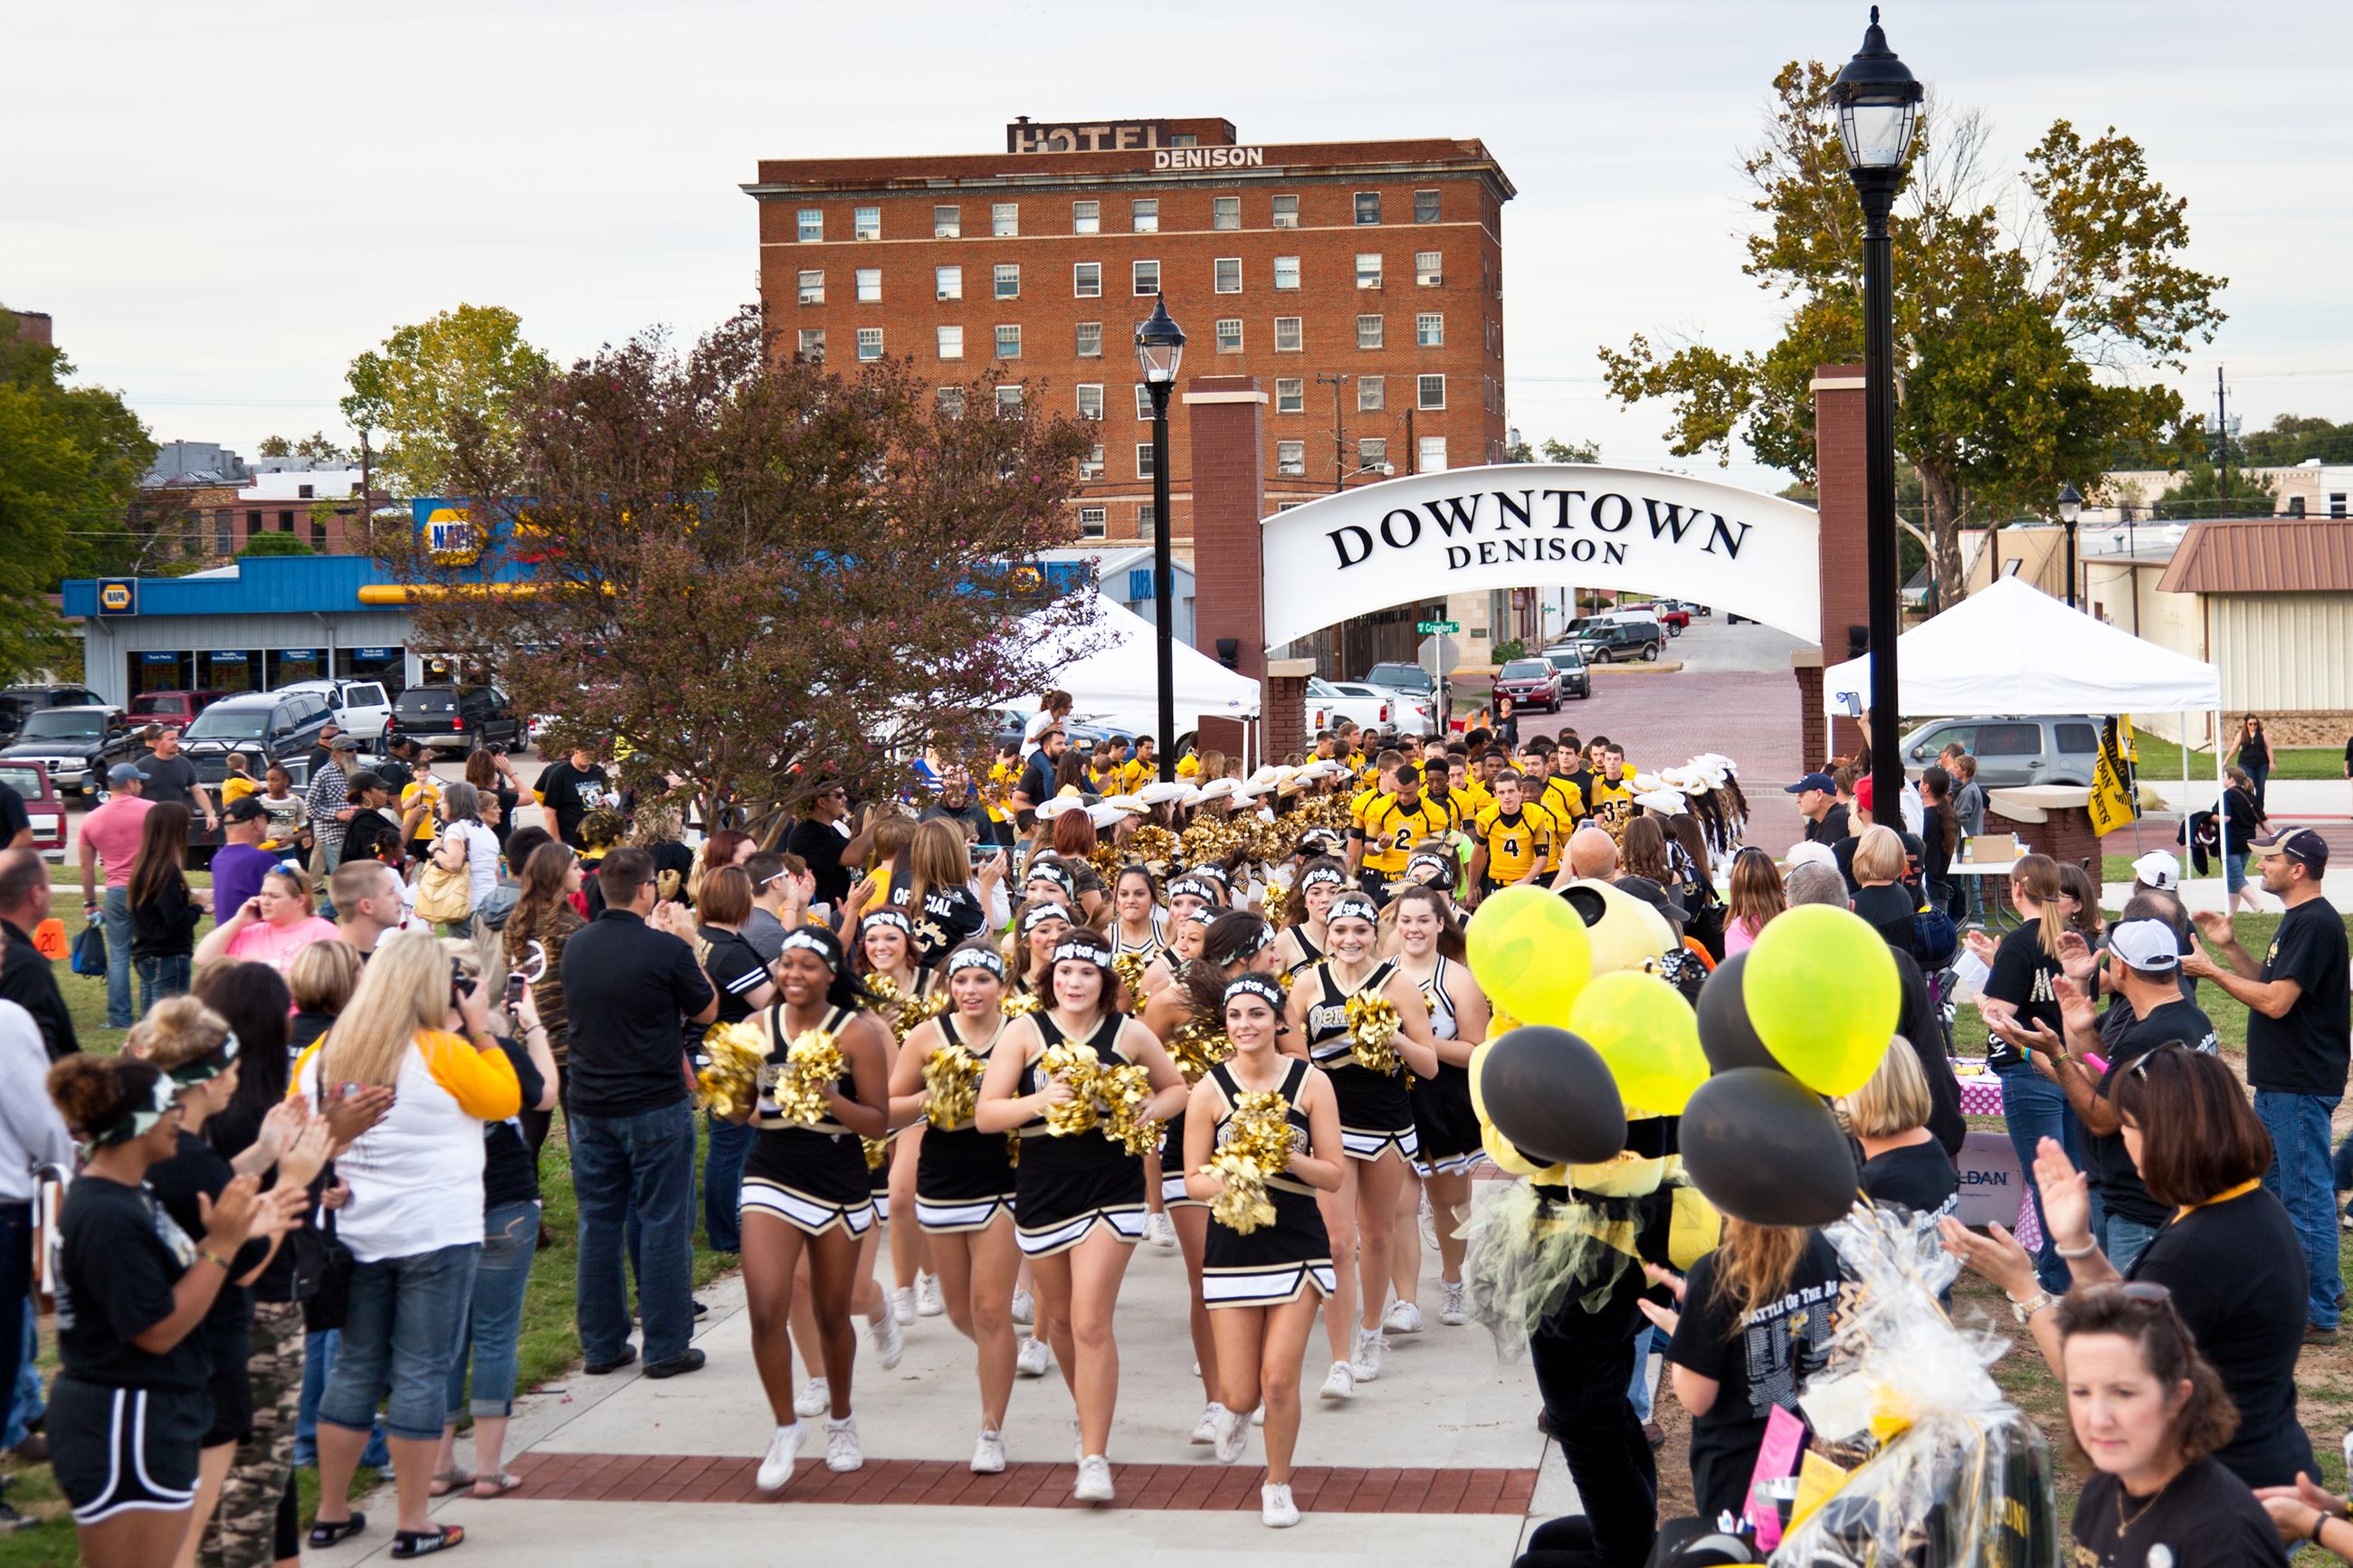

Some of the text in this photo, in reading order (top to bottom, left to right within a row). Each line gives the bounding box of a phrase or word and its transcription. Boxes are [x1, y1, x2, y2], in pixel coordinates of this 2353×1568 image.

[1015, 125, 1158, 153] HOTEL
[1155, 147, 1263, 169] DENISON
[1326, 489, 1752, 570] DOWNTOWN
[1446, 537, 1629, 570] DENISON
[107, 591, 126, 603] NAPA
[1425, 622, 1453, 632] Crawford
[2102, 725, 2128, 777] FIGHTING
[1395, 827, 1412, 851] 2
[1502, 837, 1520, 858] 4
[893, 887, 952, 917] OFCIAL
